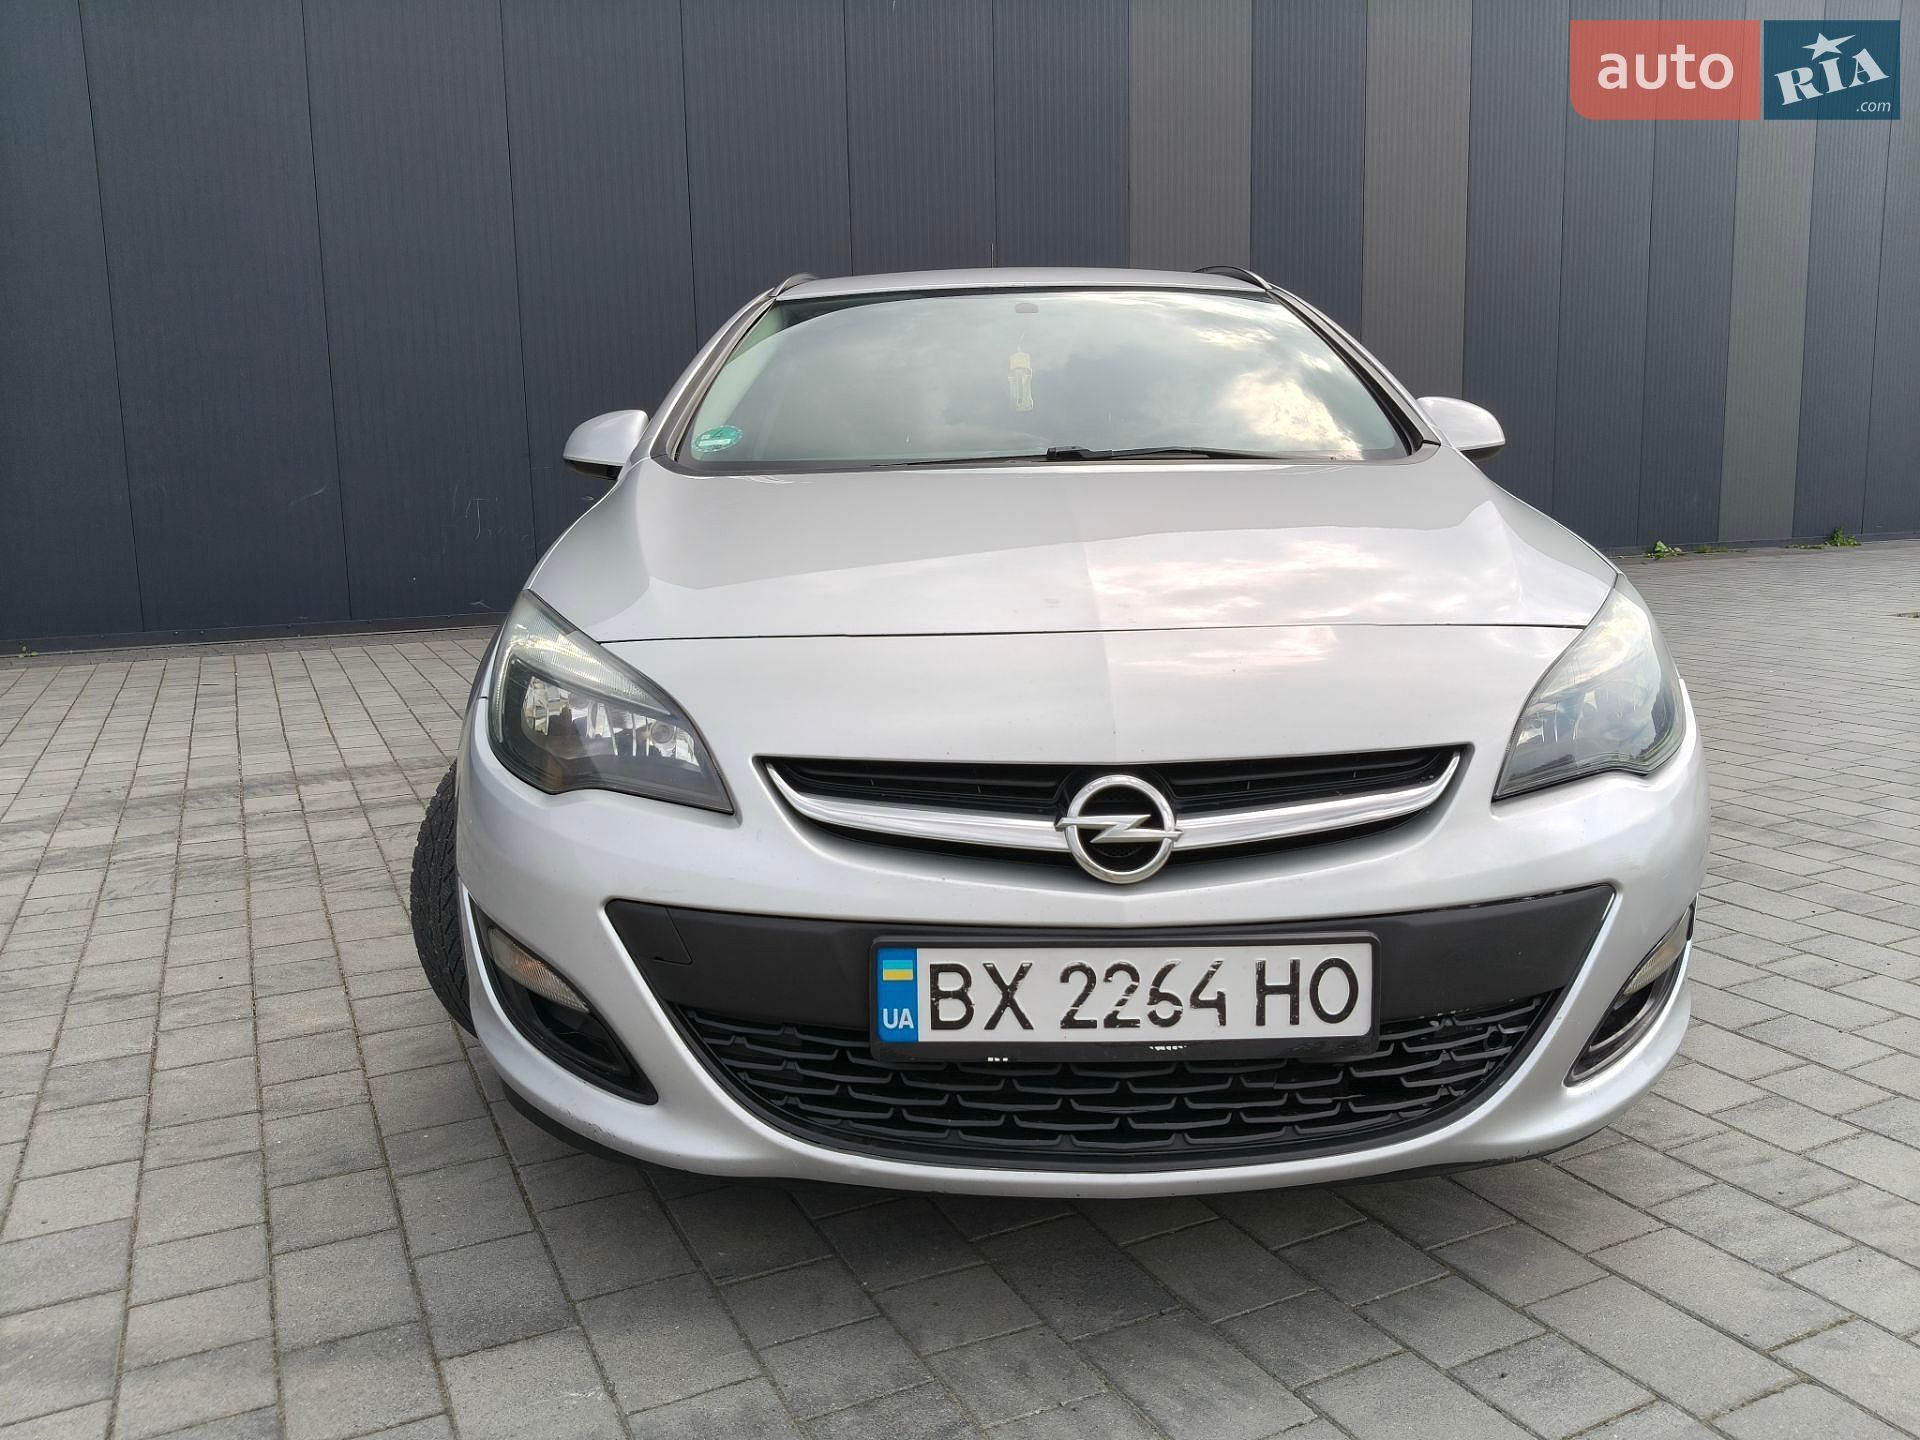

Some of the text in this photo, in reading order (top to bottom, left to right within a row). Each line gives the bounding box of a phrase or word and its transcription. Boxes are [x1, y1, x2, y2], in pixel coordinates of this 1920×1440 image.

[929, 957, 1360, 1031] BX 2264 HO
[882, 1007, 915, 1030] UA
